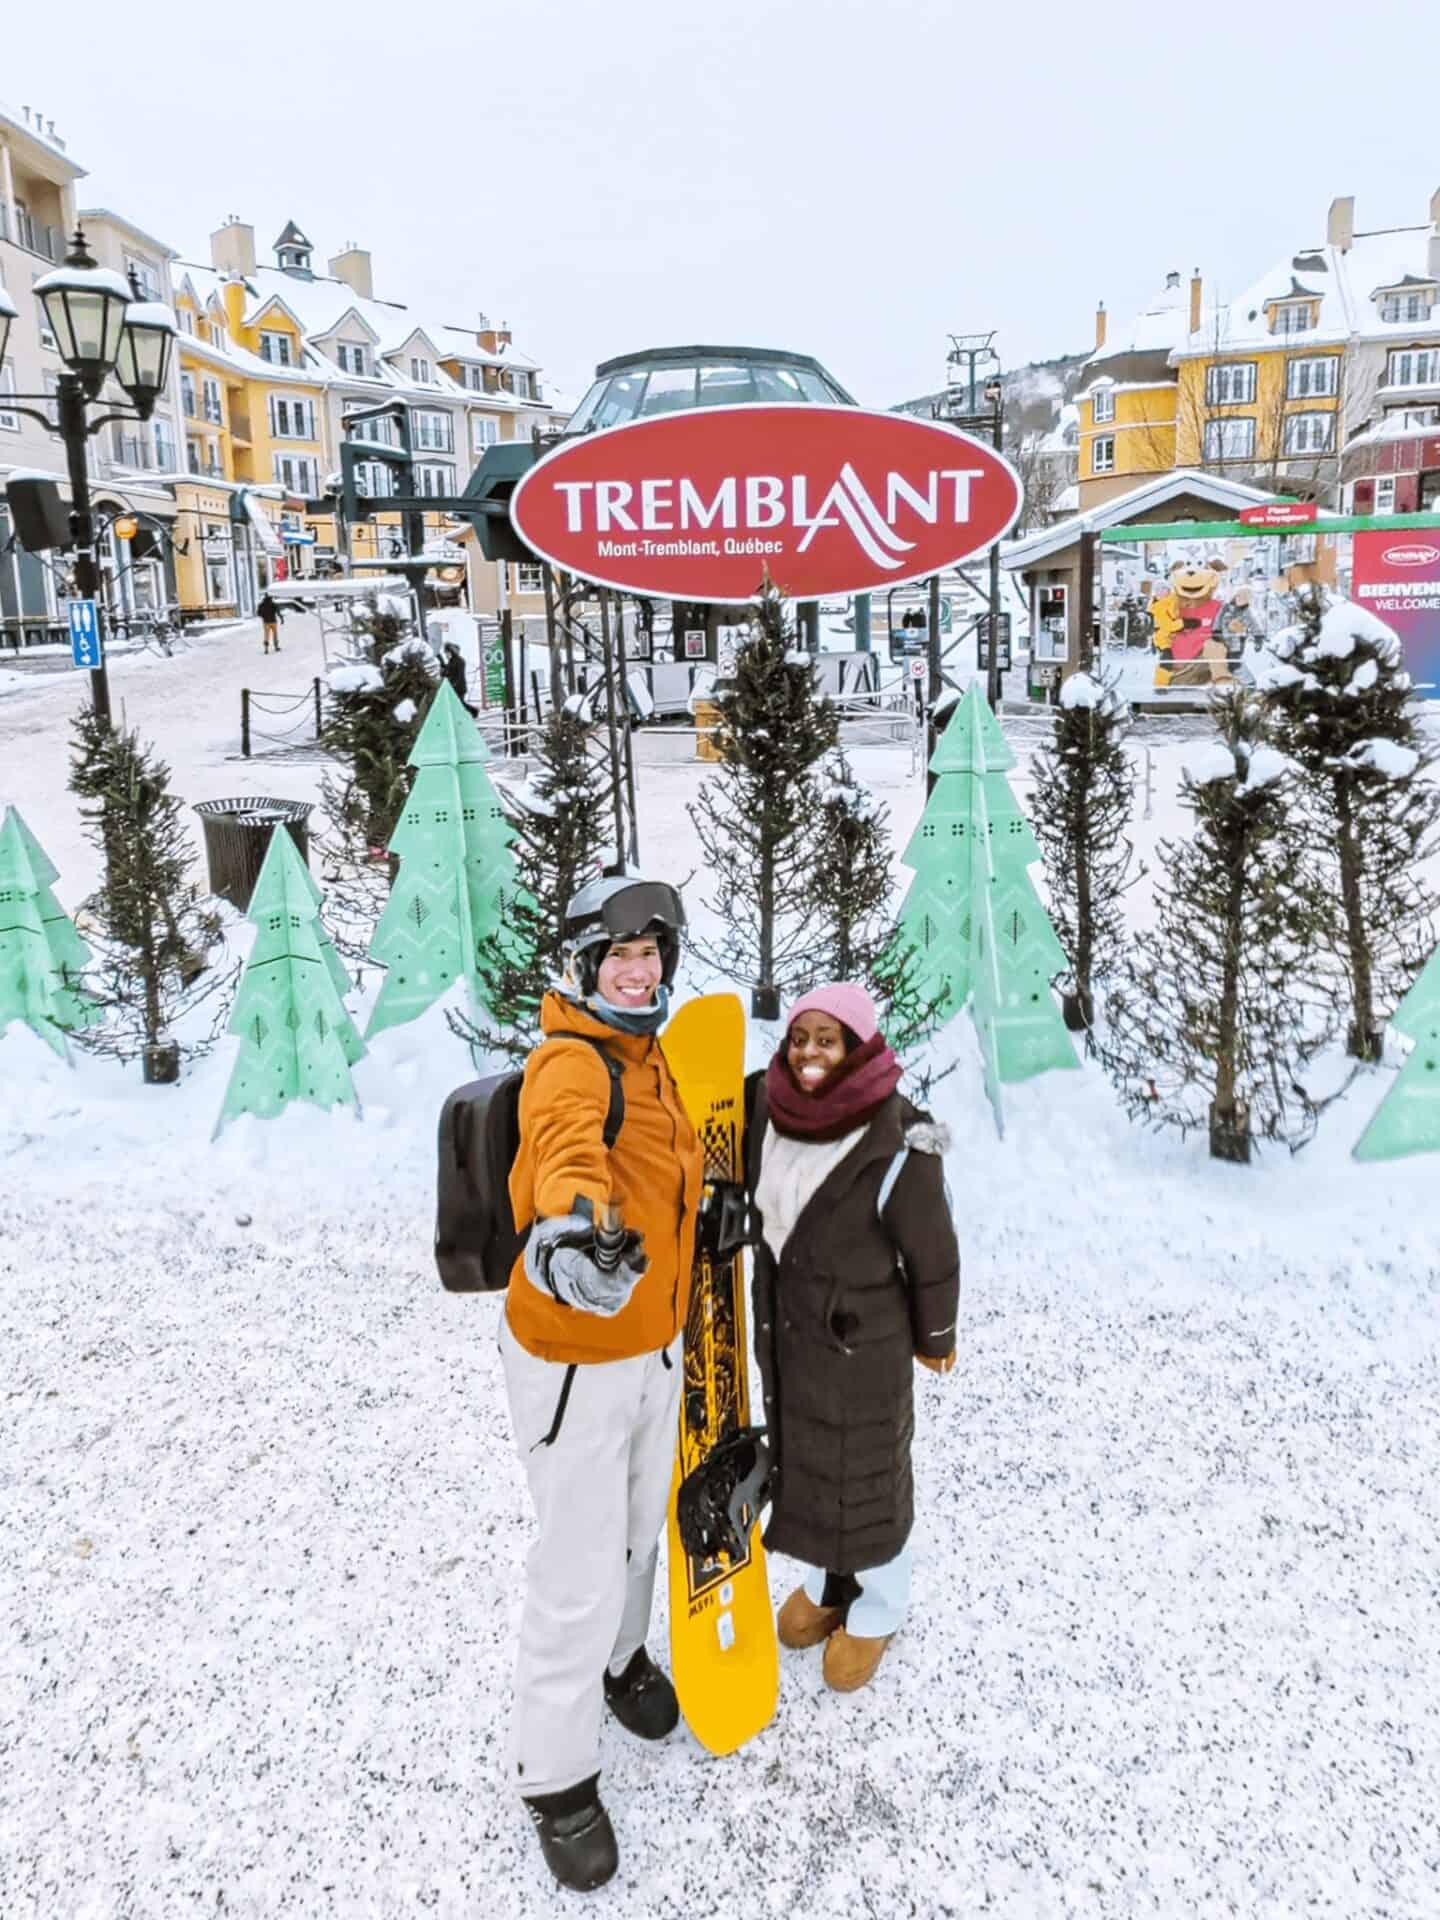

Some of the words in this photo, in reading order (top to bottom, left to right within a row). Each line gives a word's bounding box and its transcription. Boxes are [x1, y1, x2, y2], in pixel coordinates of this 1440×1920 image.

[553, 462, 985, 570] TREMBLANT
[597, 540, 720, 557] Mont-Tremblant,
[724, 537, 783, 555] Québec
